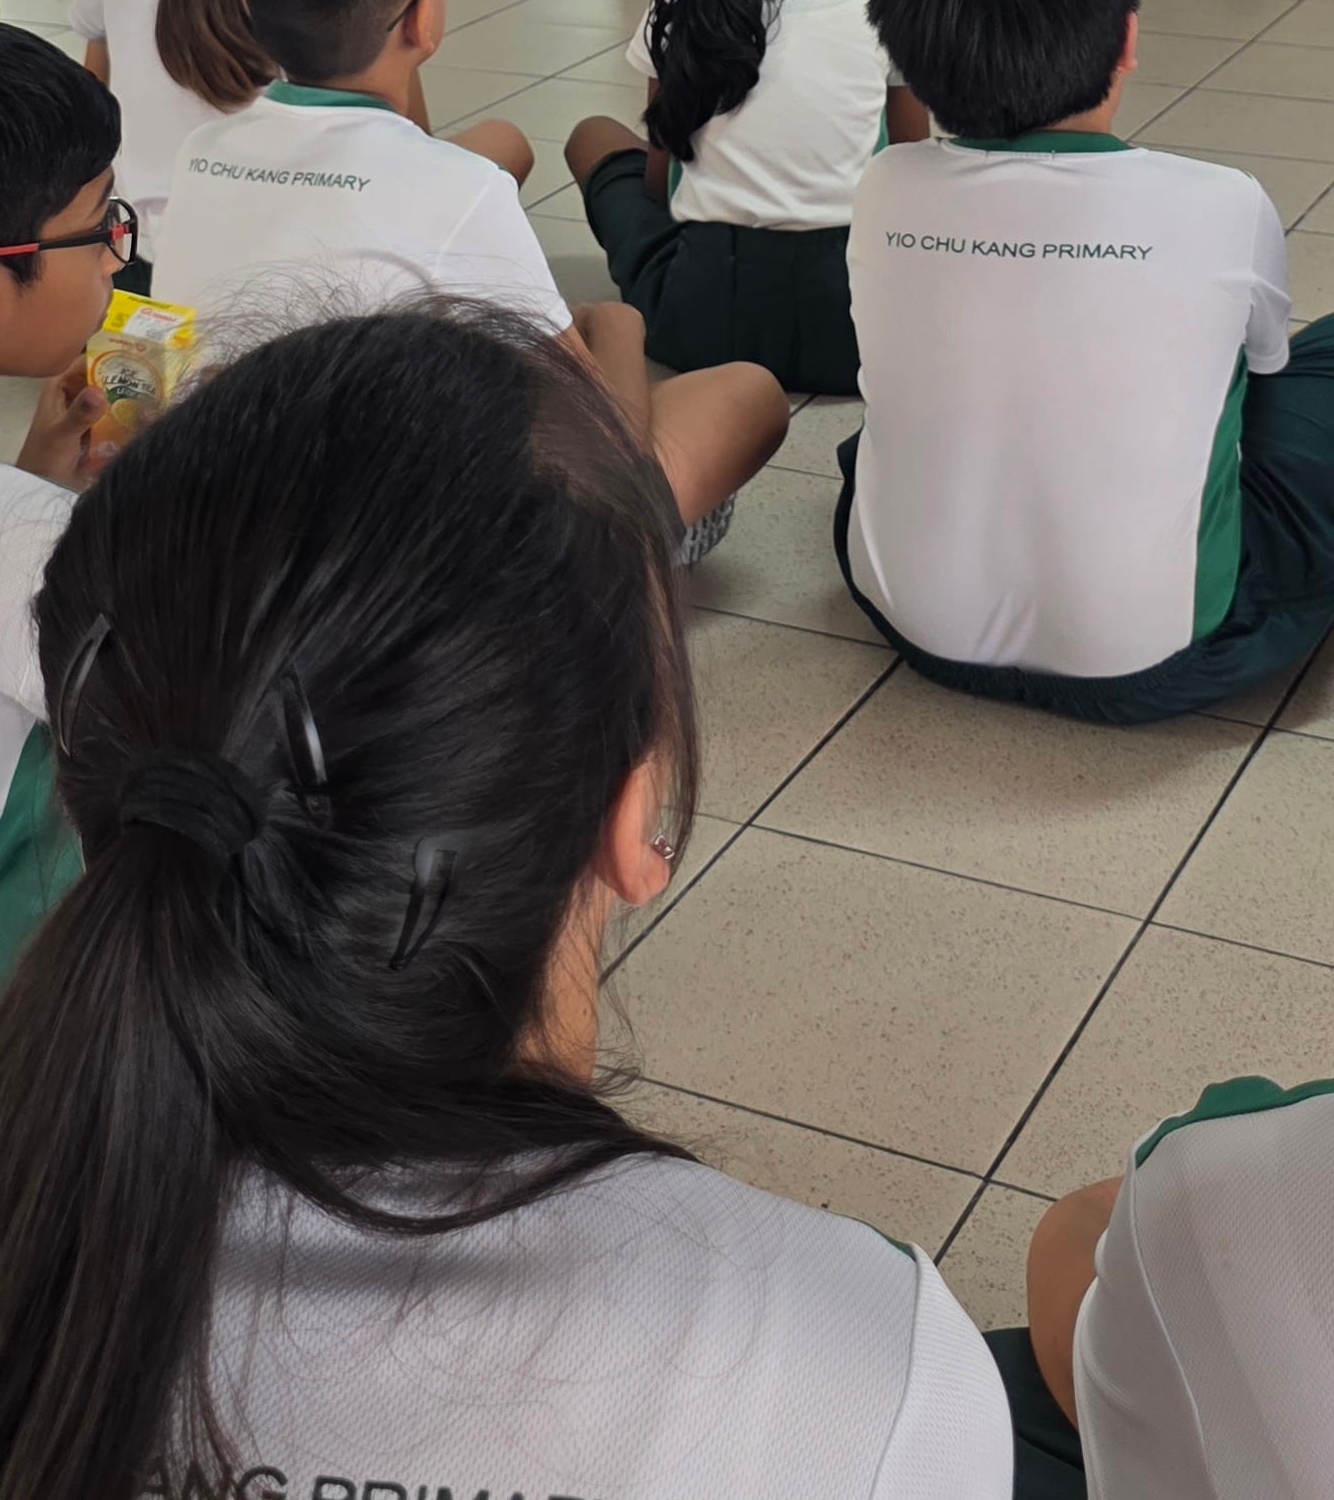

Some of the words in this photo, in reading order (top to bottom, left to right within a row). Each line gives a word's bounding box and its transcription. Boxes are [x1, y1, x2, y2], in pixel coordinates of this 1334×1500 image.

[210, 160, 246, 180] CHU
[245, 167, 290, 185] KANG
[291, 170, 372, 192] PRIMARY
[885, 231, 916, 249] YIO
[920, 235, 966, 253] CHU
[971, 239, 1036, 258] KANG
[1042, 243, 1154, 260] PRIMARY
